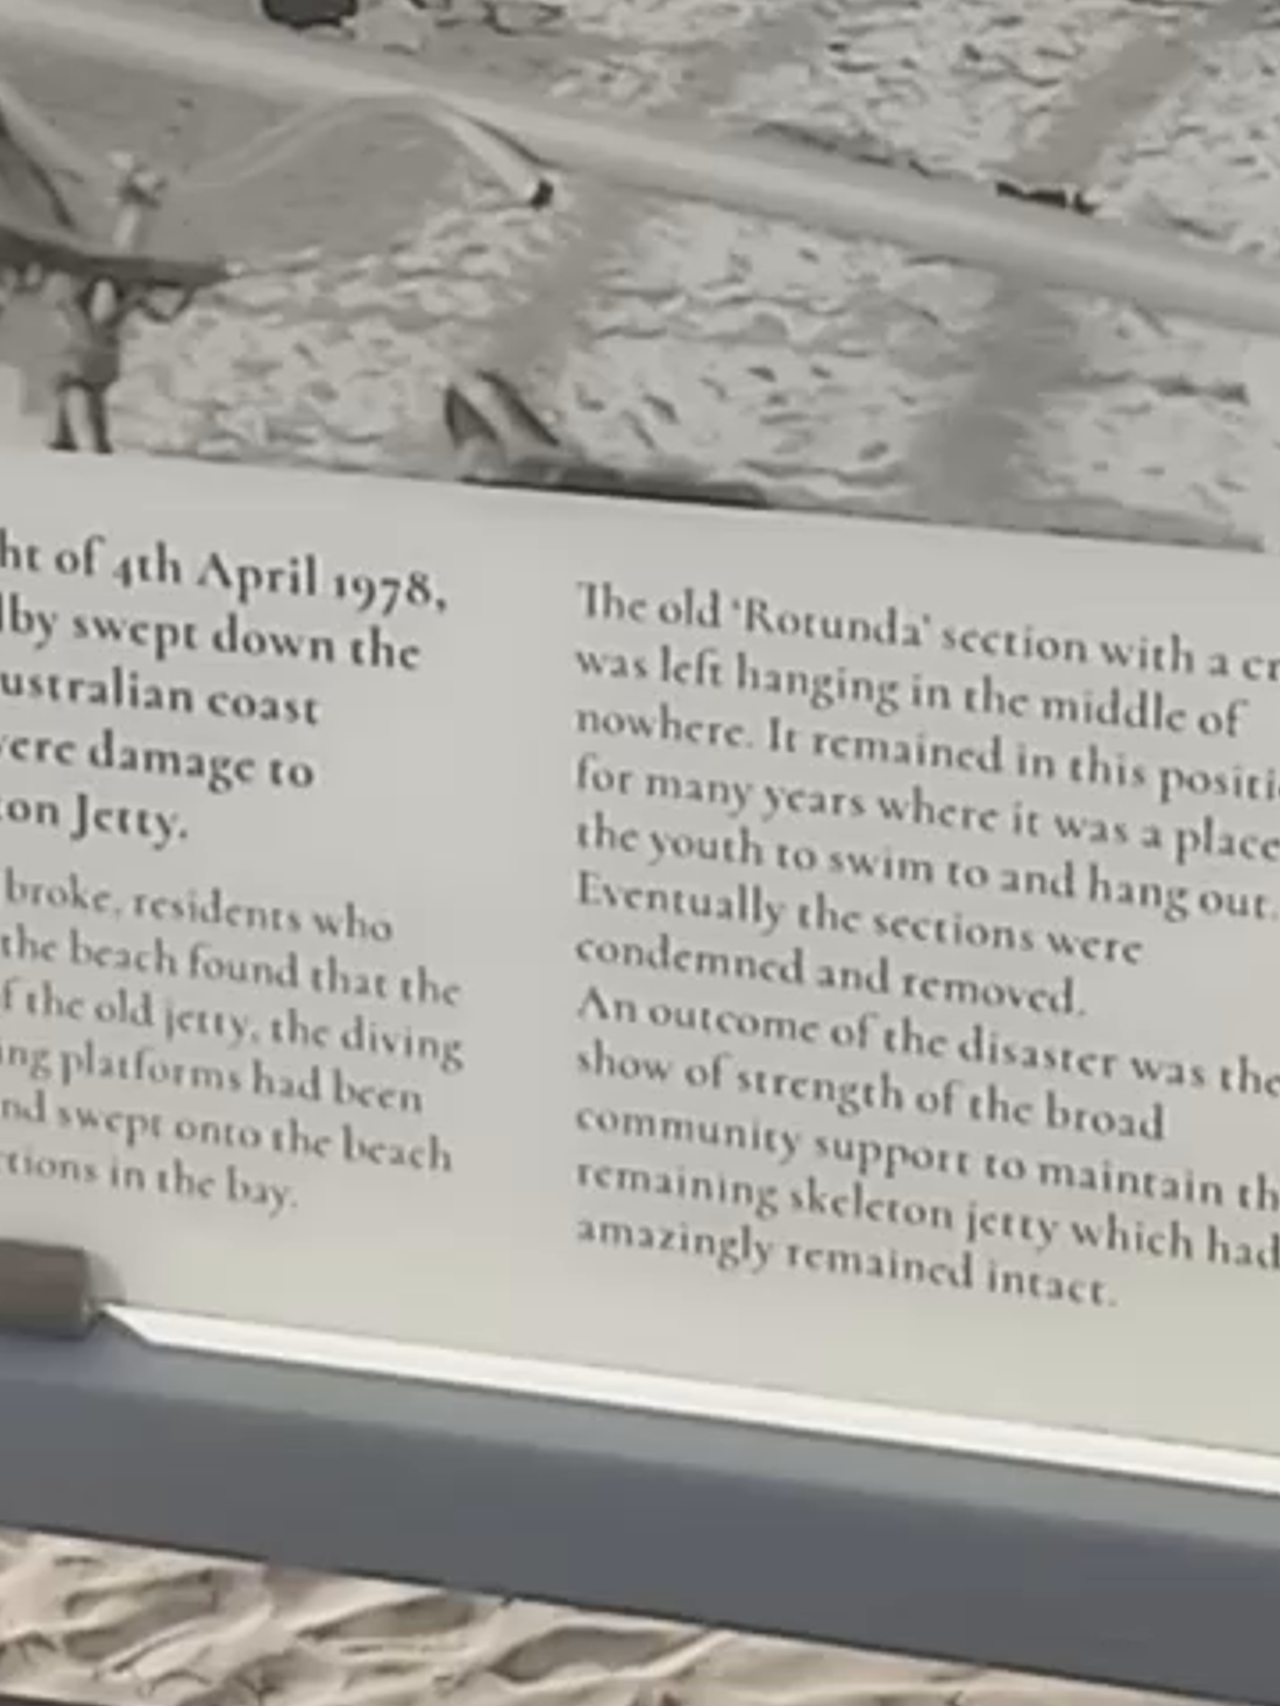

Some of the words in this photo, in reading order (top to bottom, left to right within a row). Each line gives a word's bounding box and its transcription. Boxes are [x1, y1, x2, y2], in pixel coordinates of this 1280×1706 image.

[52, 533, 108, 579] of
[111, 538, 183, 591] 4th
[195, 550, 318, 607] April
[332, 569, 449, 619] 1978,
[71, 614, 199, 664] swept
[210, 610, 337, 665] down
[348, 622, 422, 673] the
[575, 579, 649, 625] The
[656, 585, 723, 631] old
[940, 623, 1090, 666] section
[1098, 630, 1196, 677] with
[1206, 651, 1231, 679] a
[205, 690, 320, 728] coast
[573, 649, 650, 681] was
[658, 642, 724, 690] left
[735, 649, 902, 719] hanging
[909, 671, 953, 712] in
[962, 672, 1031, 720] the
[1039, 684, 1188, 735] middle
[1195, 697, 1250, 740] of
[86, 725, 257, 796] damage
[268, 757, 316, 790] to
[575, 700, 754, 750] nowhere.
[767, 714, 799, 755] It
[810, 730, 1006, 776] remained
[1015, 741, 1058, 782] in
[1067, 741, 1148, 789] this
[68, 790, 189, 853] Jetty.
[3, 864, 123, 919] broke,
[132, 885, 303, 935] residents
[310, 899, 395, 944] who
[575, 808, 641, 854] the
[646, 823, 766, 868] youth
[775, 842, 819, 873] to
[827, 850, 936, 886] swim
[946, 859, 991, 890] to
[998, 858, 1078, 901] and
[1086, 860, 1191, 925] hang
[1196, 888, 1279, 922] out.
[577, 867, 788, 939] Eventually
[796, 889, 863, 936] the
[871, 910, 1036, 953] sections
[1045, 930, 1145, 967] were
[67, 925, 180, 978] beach
[187, 939, 301, 991] found
[309, 952, 389, 1001] that
[398, 963, 462, 1009] the
[55, 1105, 163, 1151] swept
[172, 1117, 264, 1151] onto
[269, 1114, 334, 1160] the
[339, 1120, 454, 1175] beach
[573, 1106, 803, 1168] community
[813, 1134, 971, 1181] support
[983, 1152, 1029, 1182] to
[1036, 1157, 1225, 1209] maintain
[108, 1155, 147, 1193] in
[155, 1155, 217, 1201] the
[224, 1162, 299, 1220] bay.
[575, 1162, 780, 1223] remaining
[788, 1173, 955, 1233] skeleton
[965, 1199, 1060, 1256] jetty
[1069, 1209, 1195, 1263] which
[576, 1217, 776, 1277] amazingly
[785, 1242, 975, 1291] remained
[985, 1257, 1117, 1308] intact.
